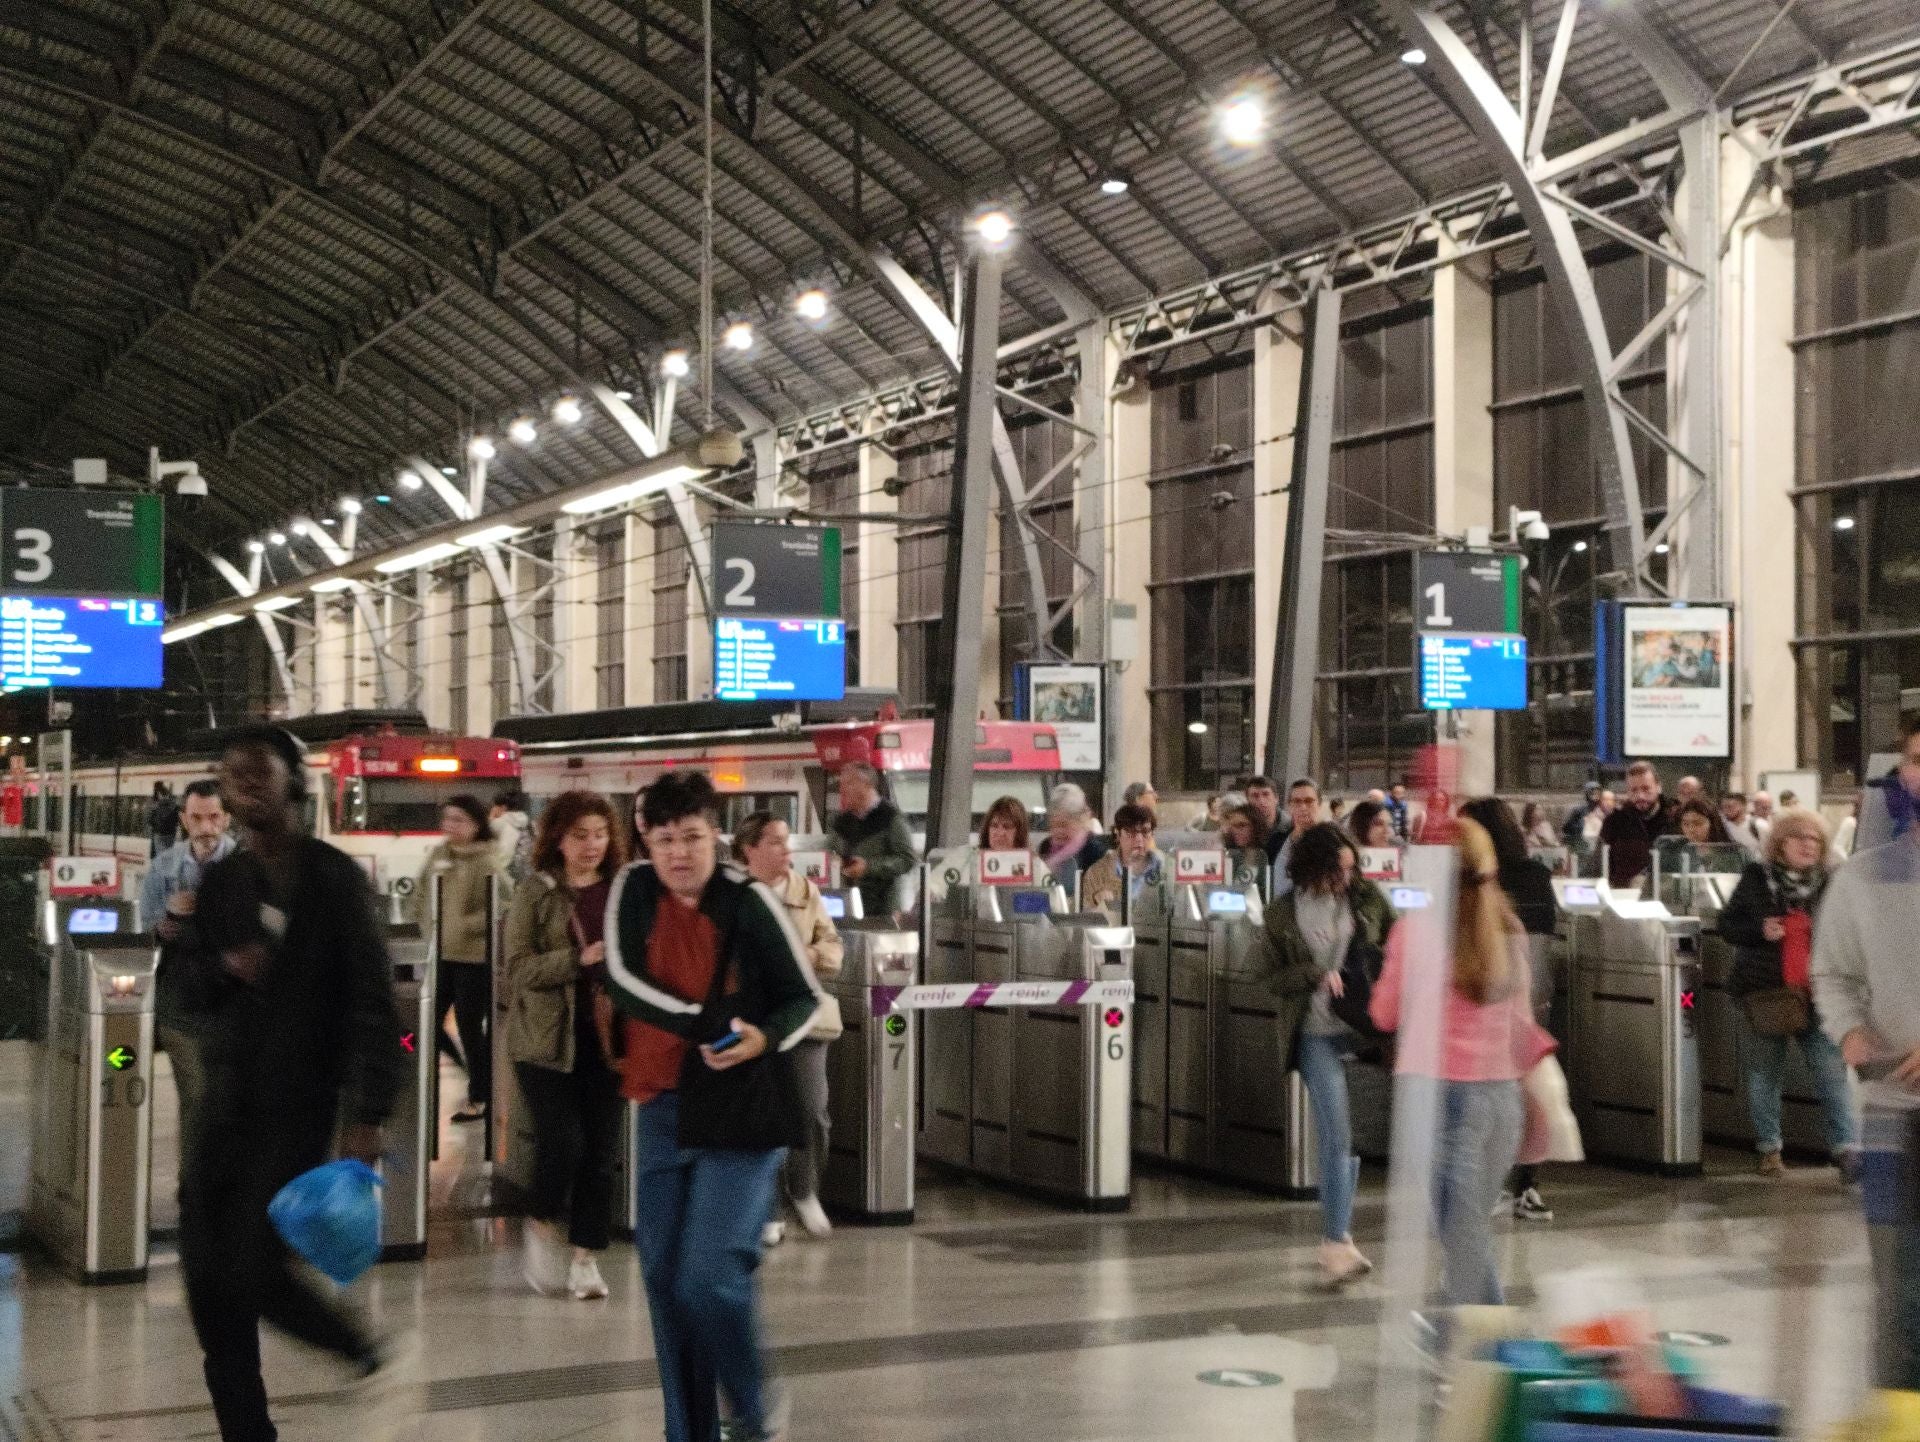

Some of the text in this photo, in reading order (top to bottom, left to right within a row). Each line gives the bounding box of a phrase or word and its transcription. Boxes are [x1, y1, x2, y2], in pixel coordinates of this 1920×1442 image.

[13, 527, 53, 583] 3
[725, 557, 756, 607] 2
[1425, 582, 1453, 626] 1
[913, 989, 957, 1005] renfe
[1008, 984, 1051, 1001] renfe
[888, 1042, 906, 1071] 7
[1106, 1033, 1124, 1061] 6
[101, 1076, 146, 1108] 10
